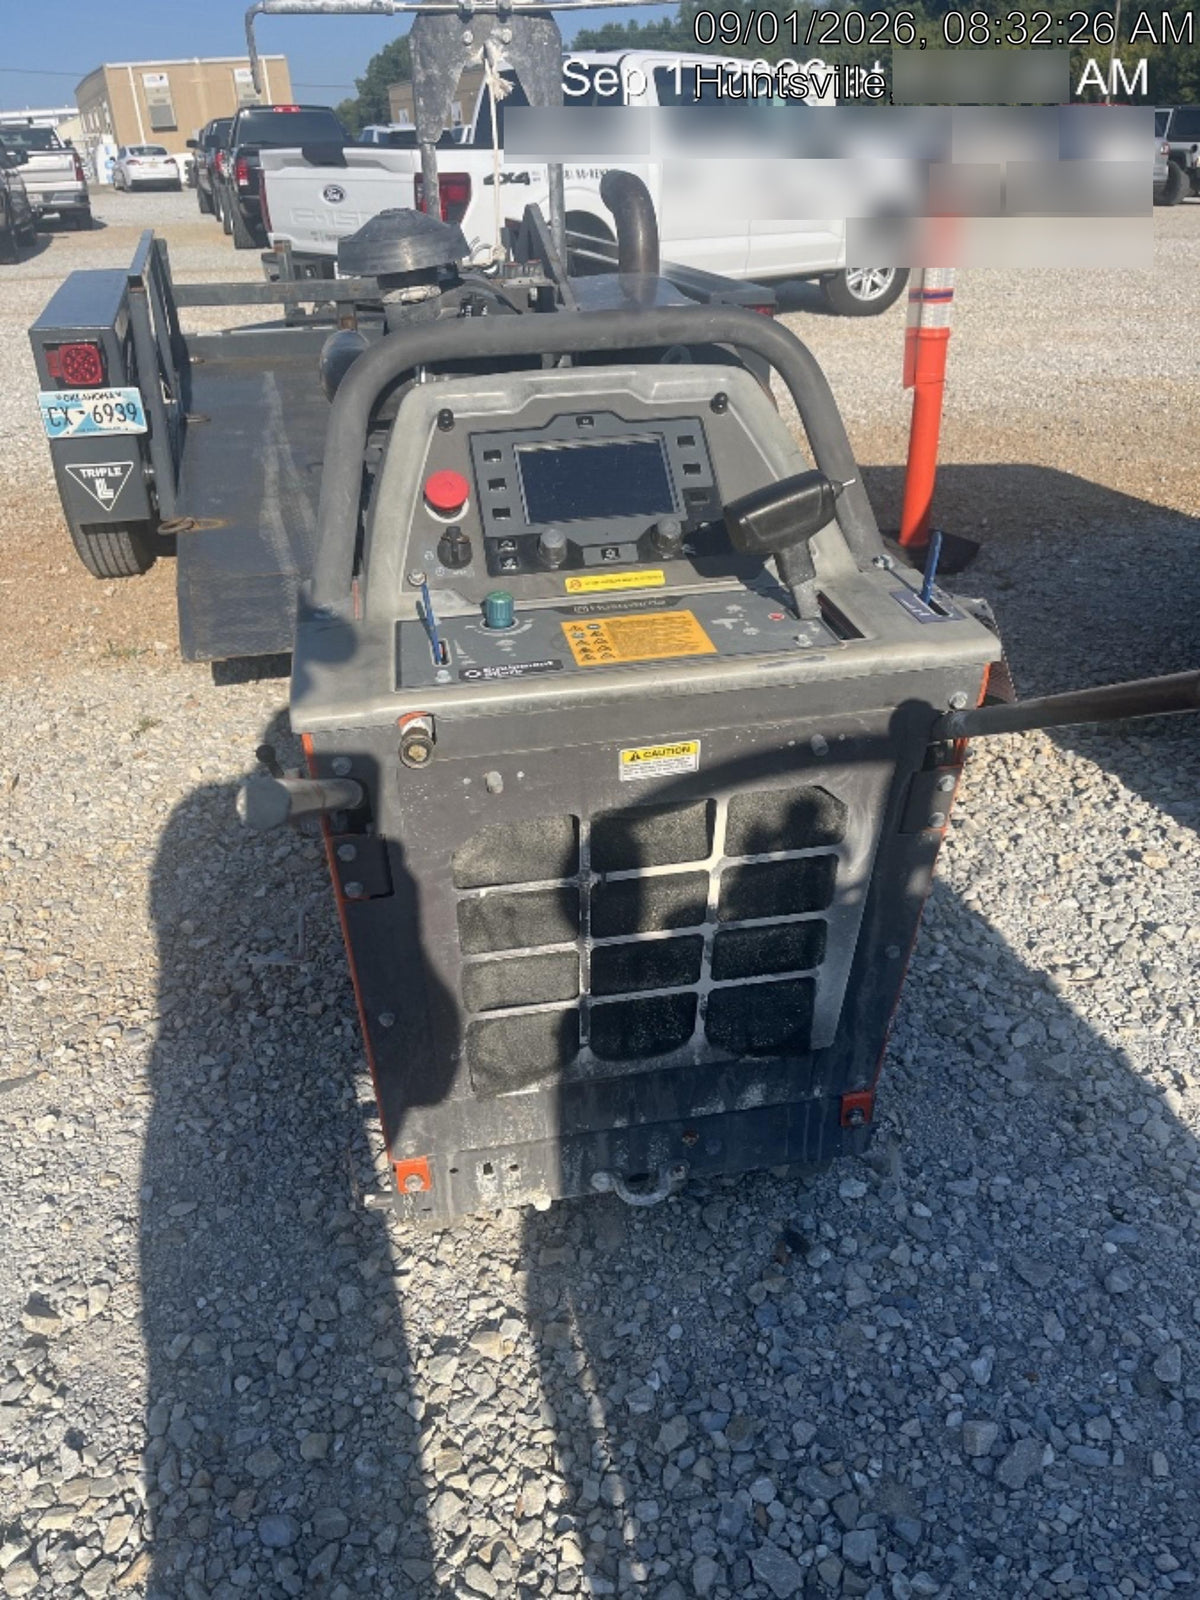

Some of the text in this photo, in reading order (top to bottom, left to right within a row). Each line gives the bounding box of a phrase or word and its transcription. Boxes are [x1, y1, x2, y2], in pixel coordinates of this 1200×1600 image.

[47, 402, 137, 427] CX 6939
[80, 467, 122, 478] TRIPLE
[643, 746, 691, 758] CAUTION
